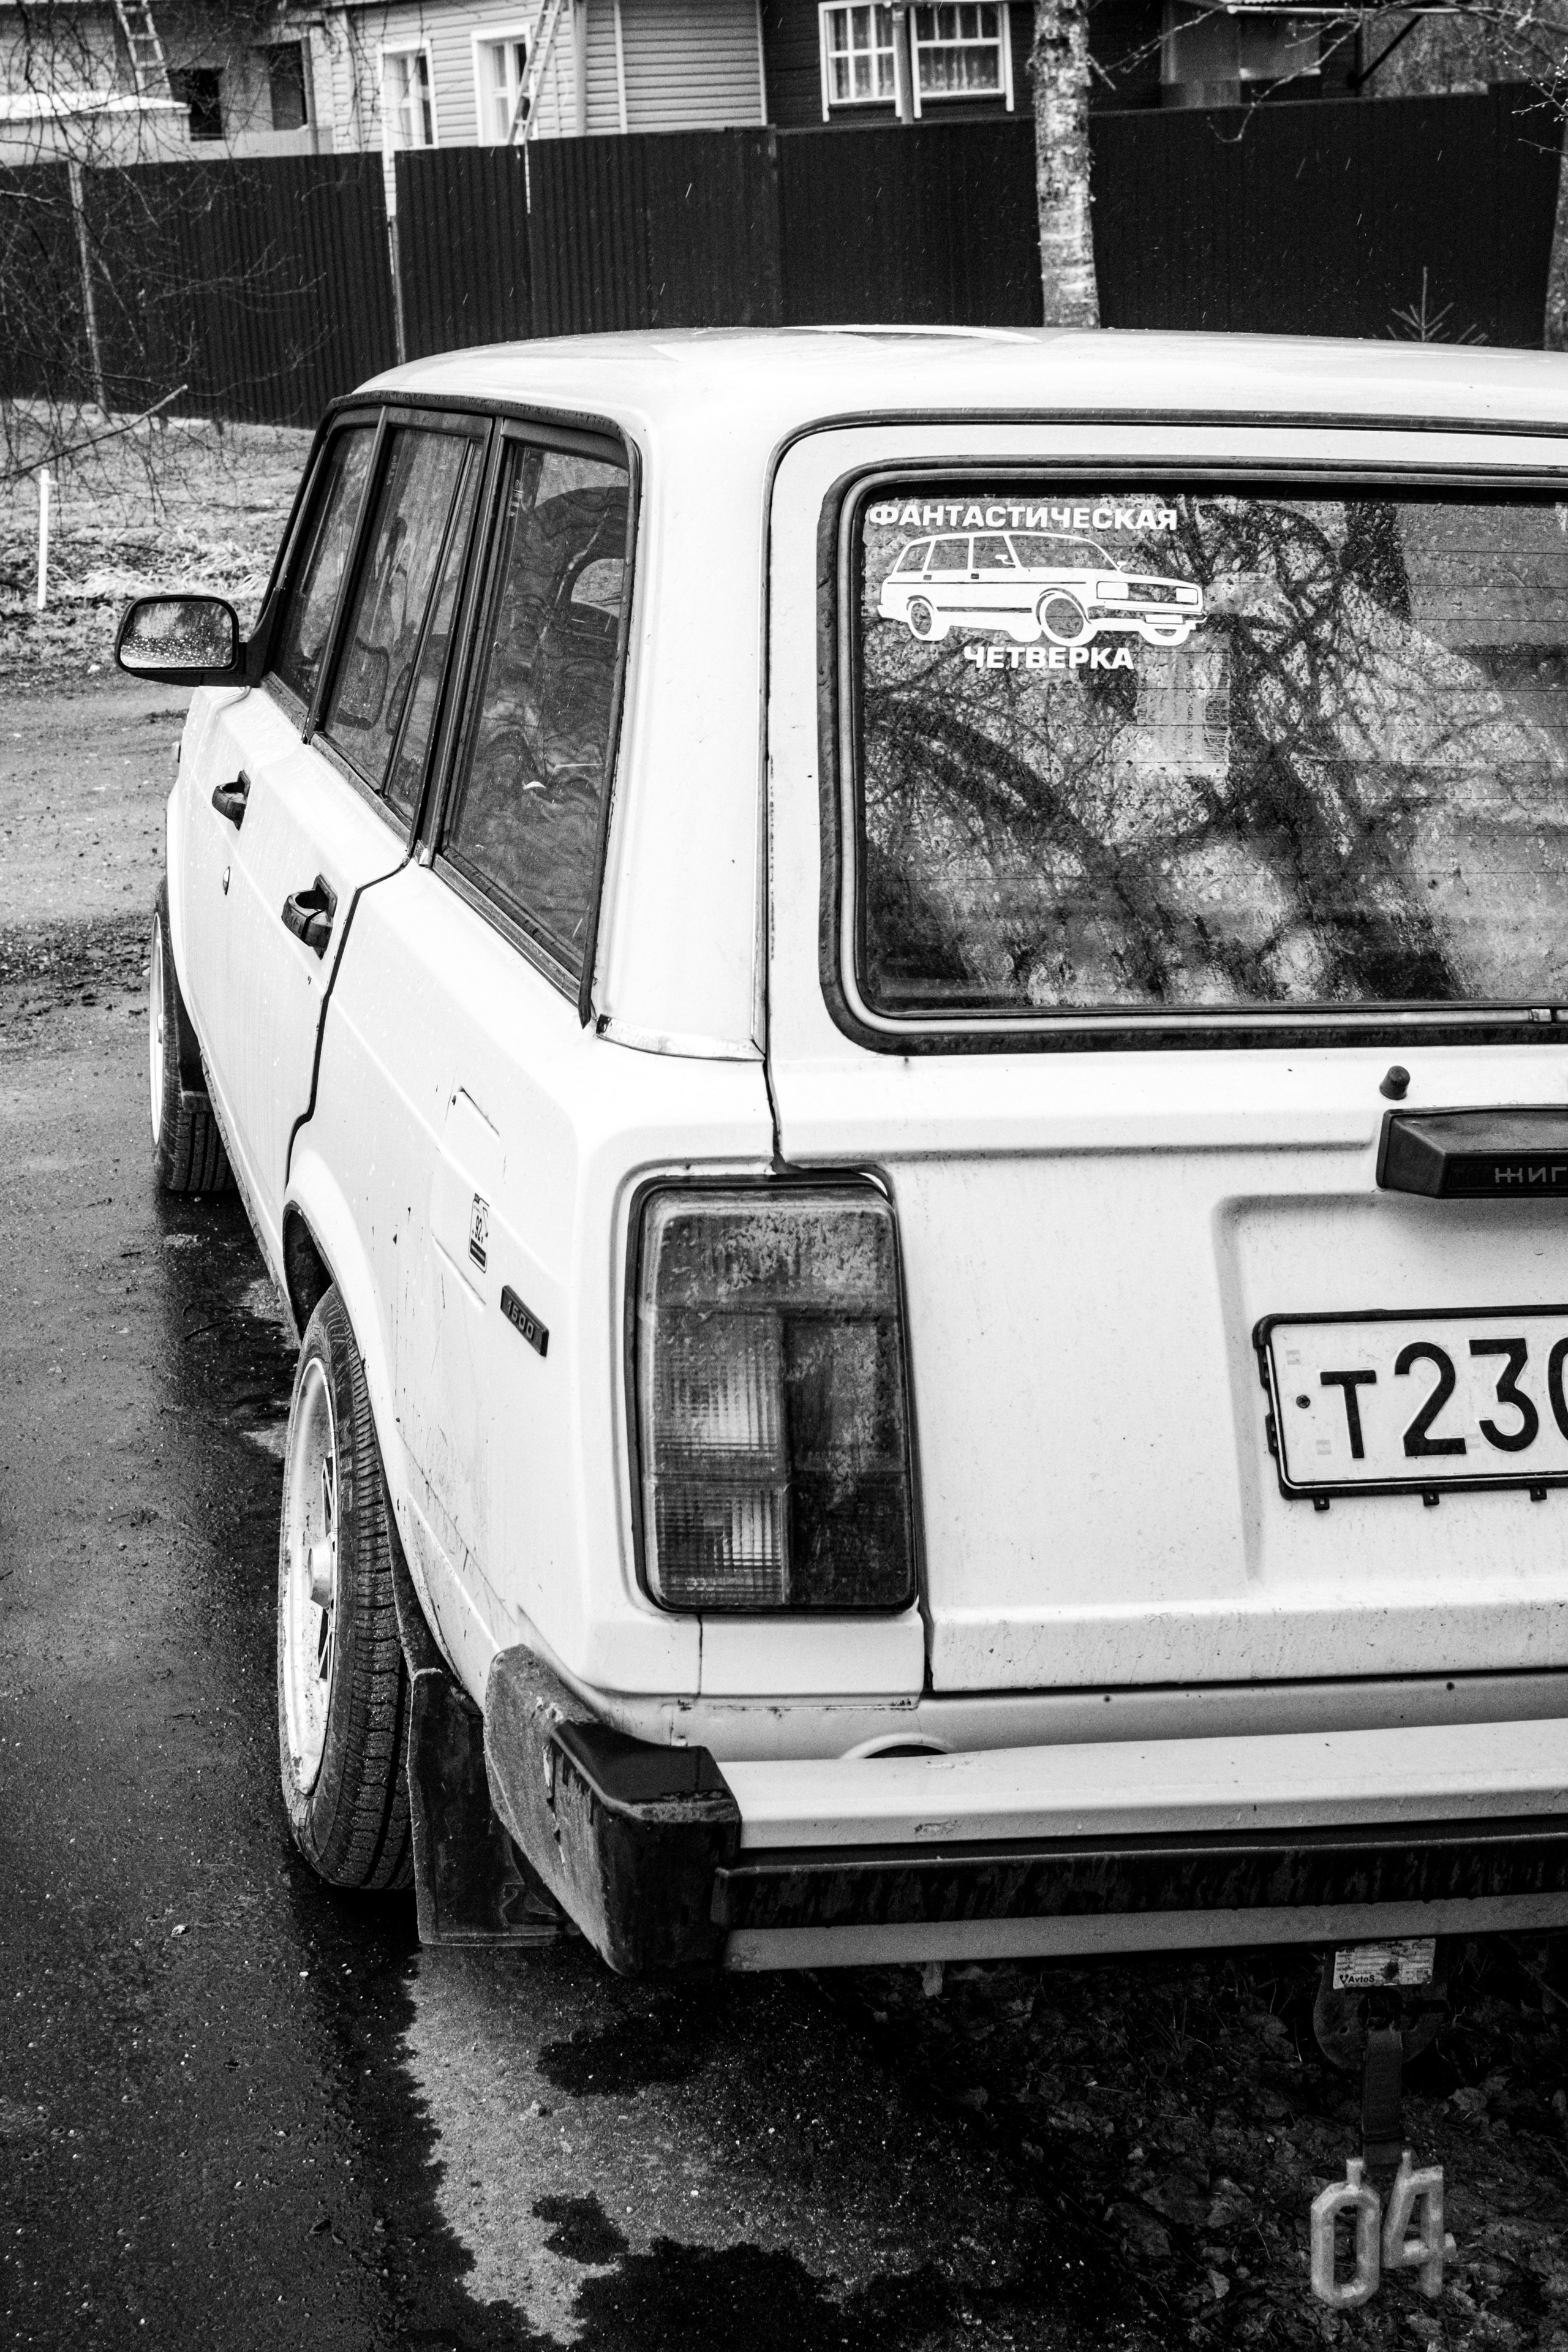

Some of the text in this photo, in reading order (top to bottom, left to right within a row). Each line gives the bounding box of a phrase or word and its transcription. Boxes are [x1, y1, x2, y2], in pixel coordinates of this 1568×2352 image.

[869, 505, 1177, 530] ФАНТАСТИЧЕСКАЯ
[963, 646, 1134, 669] ЧЕТВЕРКА
[507, 1300, 534, 1340] 1500
